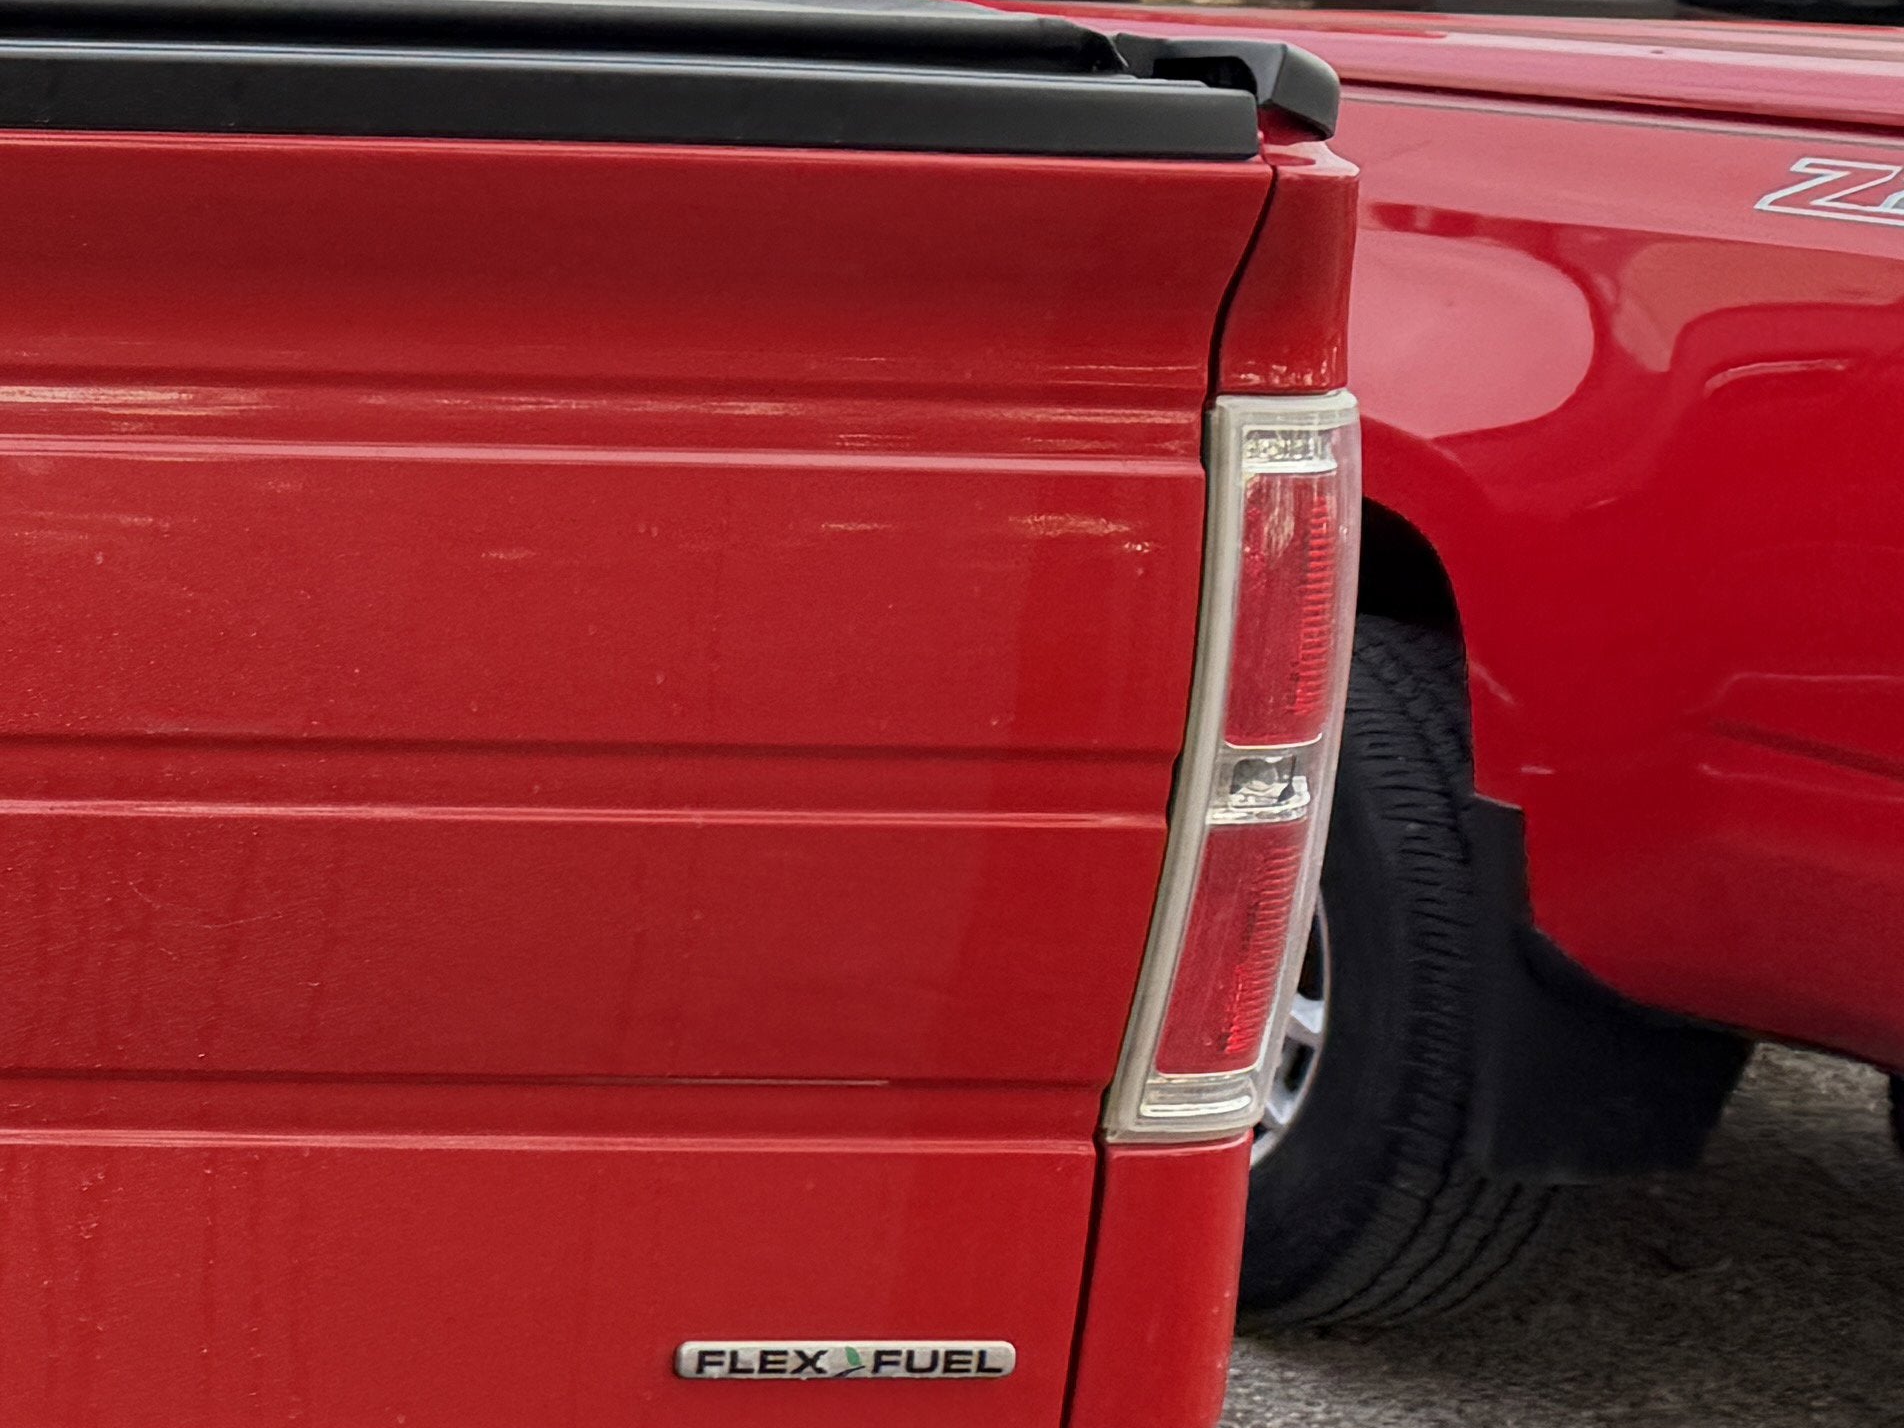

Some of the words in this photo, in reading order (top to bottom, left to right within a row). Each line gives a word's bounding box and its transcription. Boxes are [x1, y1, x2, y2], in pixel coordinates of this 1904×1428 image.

[1754, 157, 1904, 227] Z
[695, 1349, 829, 1375] FLEX
[871, 1349, 1005, 1374] FUEL
